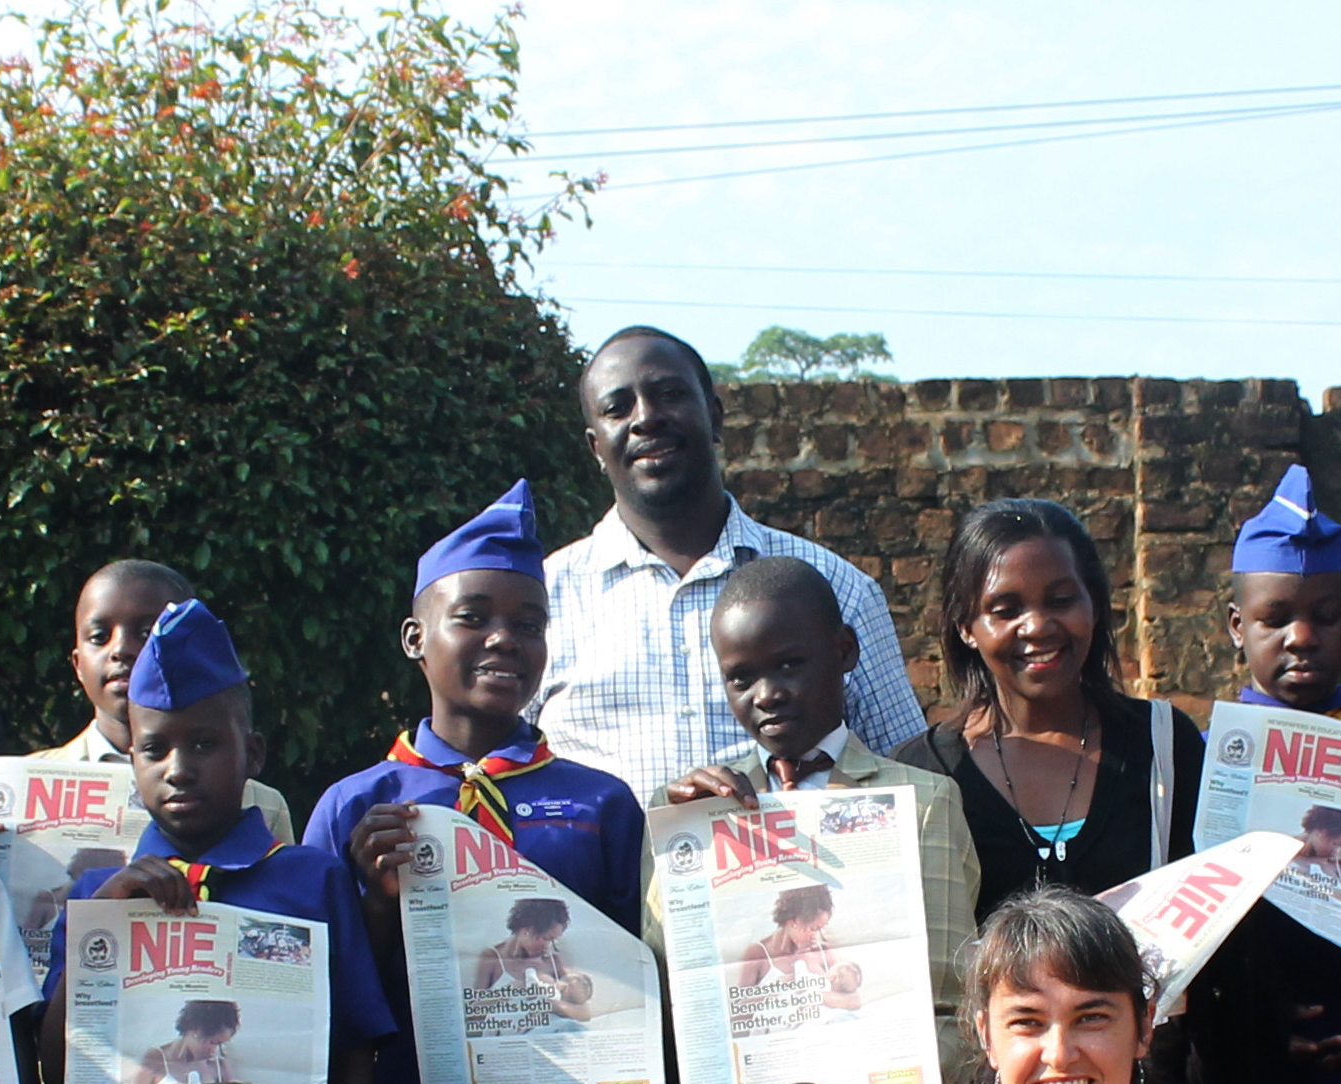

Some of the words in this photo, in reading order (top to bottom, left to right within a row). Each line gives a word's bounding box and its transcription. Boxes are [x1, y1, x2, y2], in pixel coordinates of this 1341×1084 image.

[25, 778, 109, 820] NiE
[712, 810, 800, 871] NiE
[130, 921, 217, 972] NiE
[463, 985, 556, 1001] Breastfeeding
[729, 976, 826, 1000] Breastfeeding
[465, 1001, 519, 1015] benefits
[520, 999, 551, 1012] both
[731, 998, 788, 1015] benefits
[791, 992, 822, 1009] both
[467, 1017, 516, 1031] mother,
[518, 1015, 550, 1028] child
[732, 1014, 786, 1031] mother,
[788, 1007, 821, 1023] child
